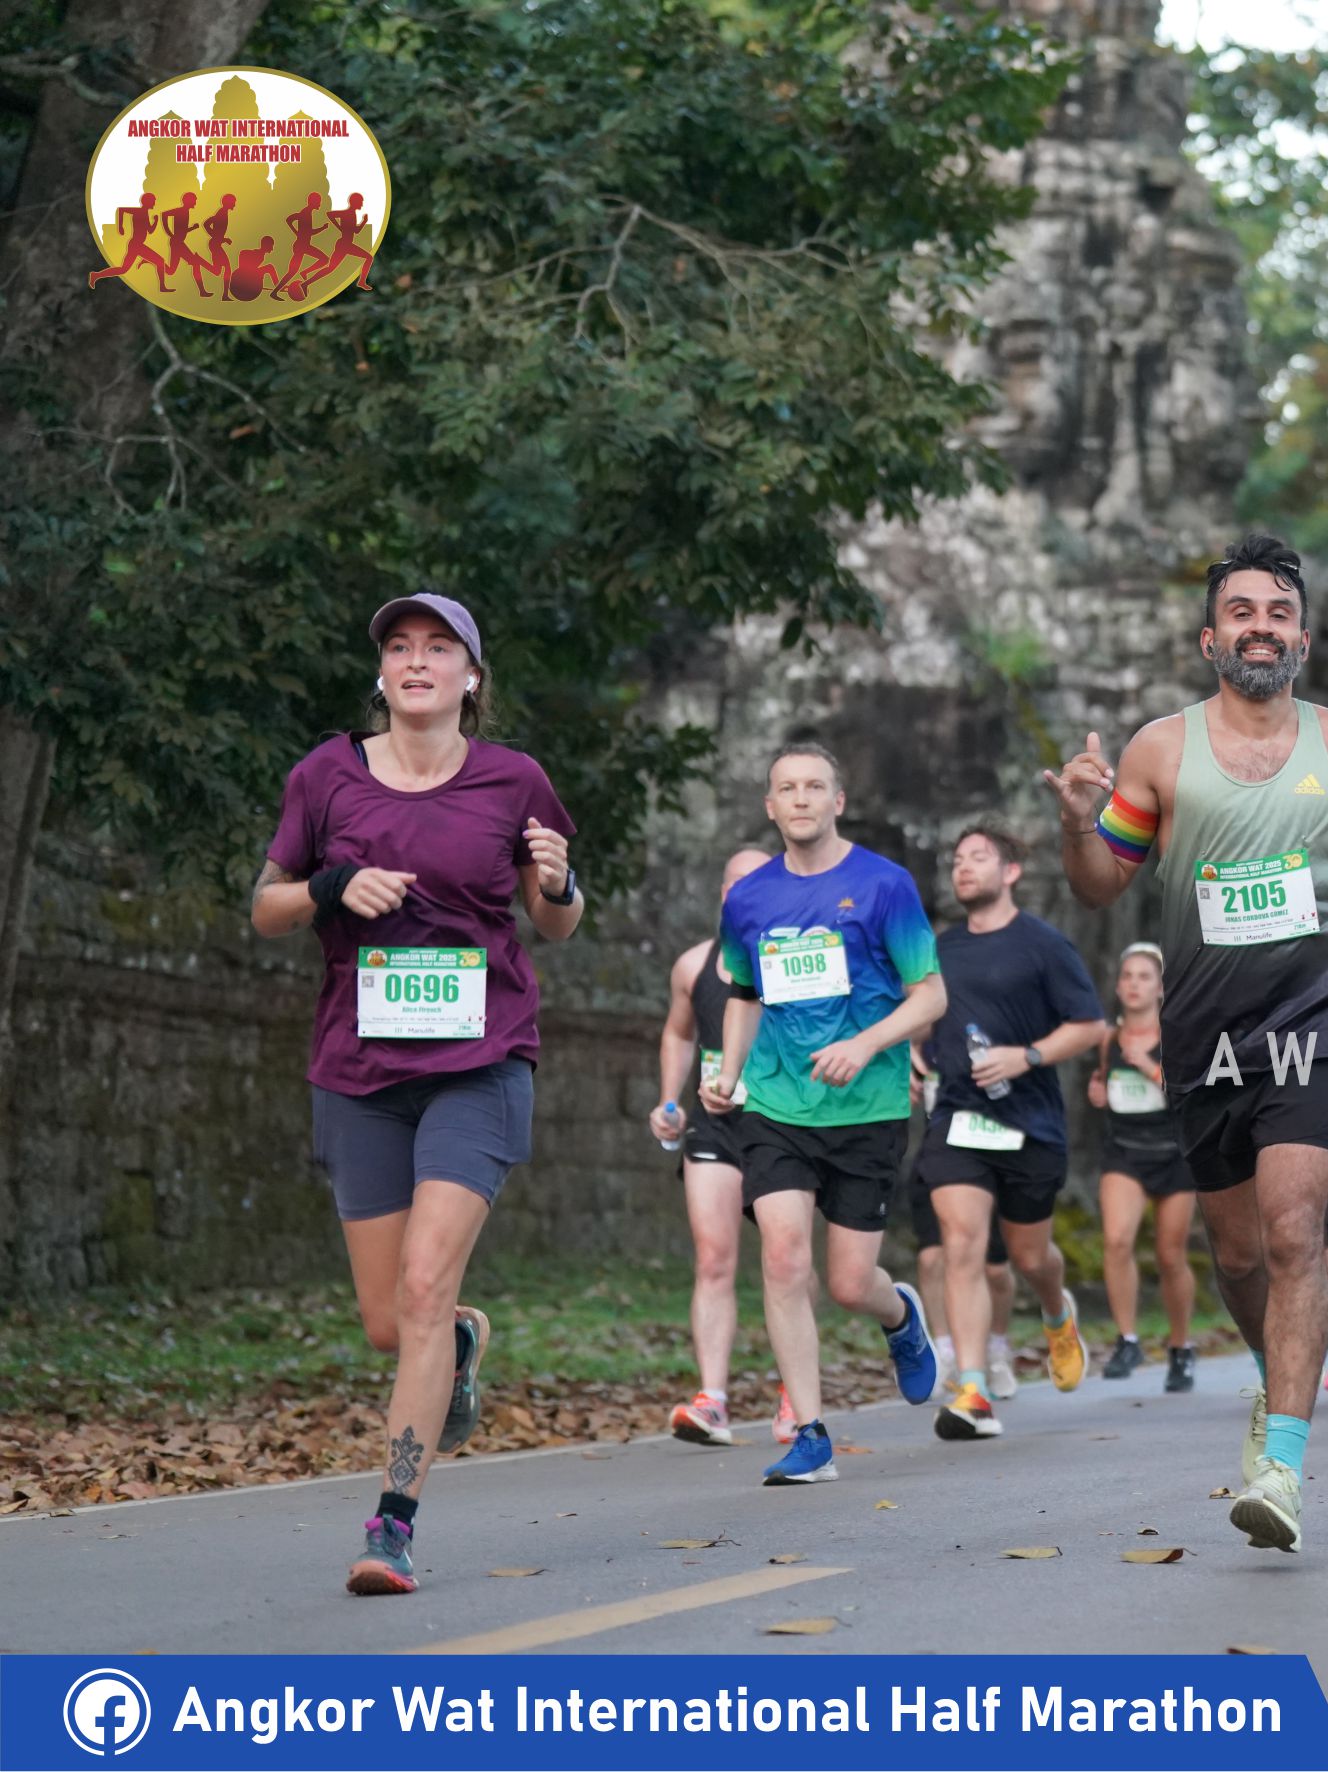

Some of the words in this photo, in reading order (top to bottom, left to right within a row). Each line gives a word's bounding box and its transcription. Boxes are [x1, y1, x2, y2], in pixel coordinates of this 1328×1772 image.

[1294, 787, 1326, 796] adidas
[1221, 880, 1286, 913] 2105
[1246, 931, 1273, 941] Manulife
[780, 952, 827, 977] 1098
[384, 973, 460, 1004] 0696
